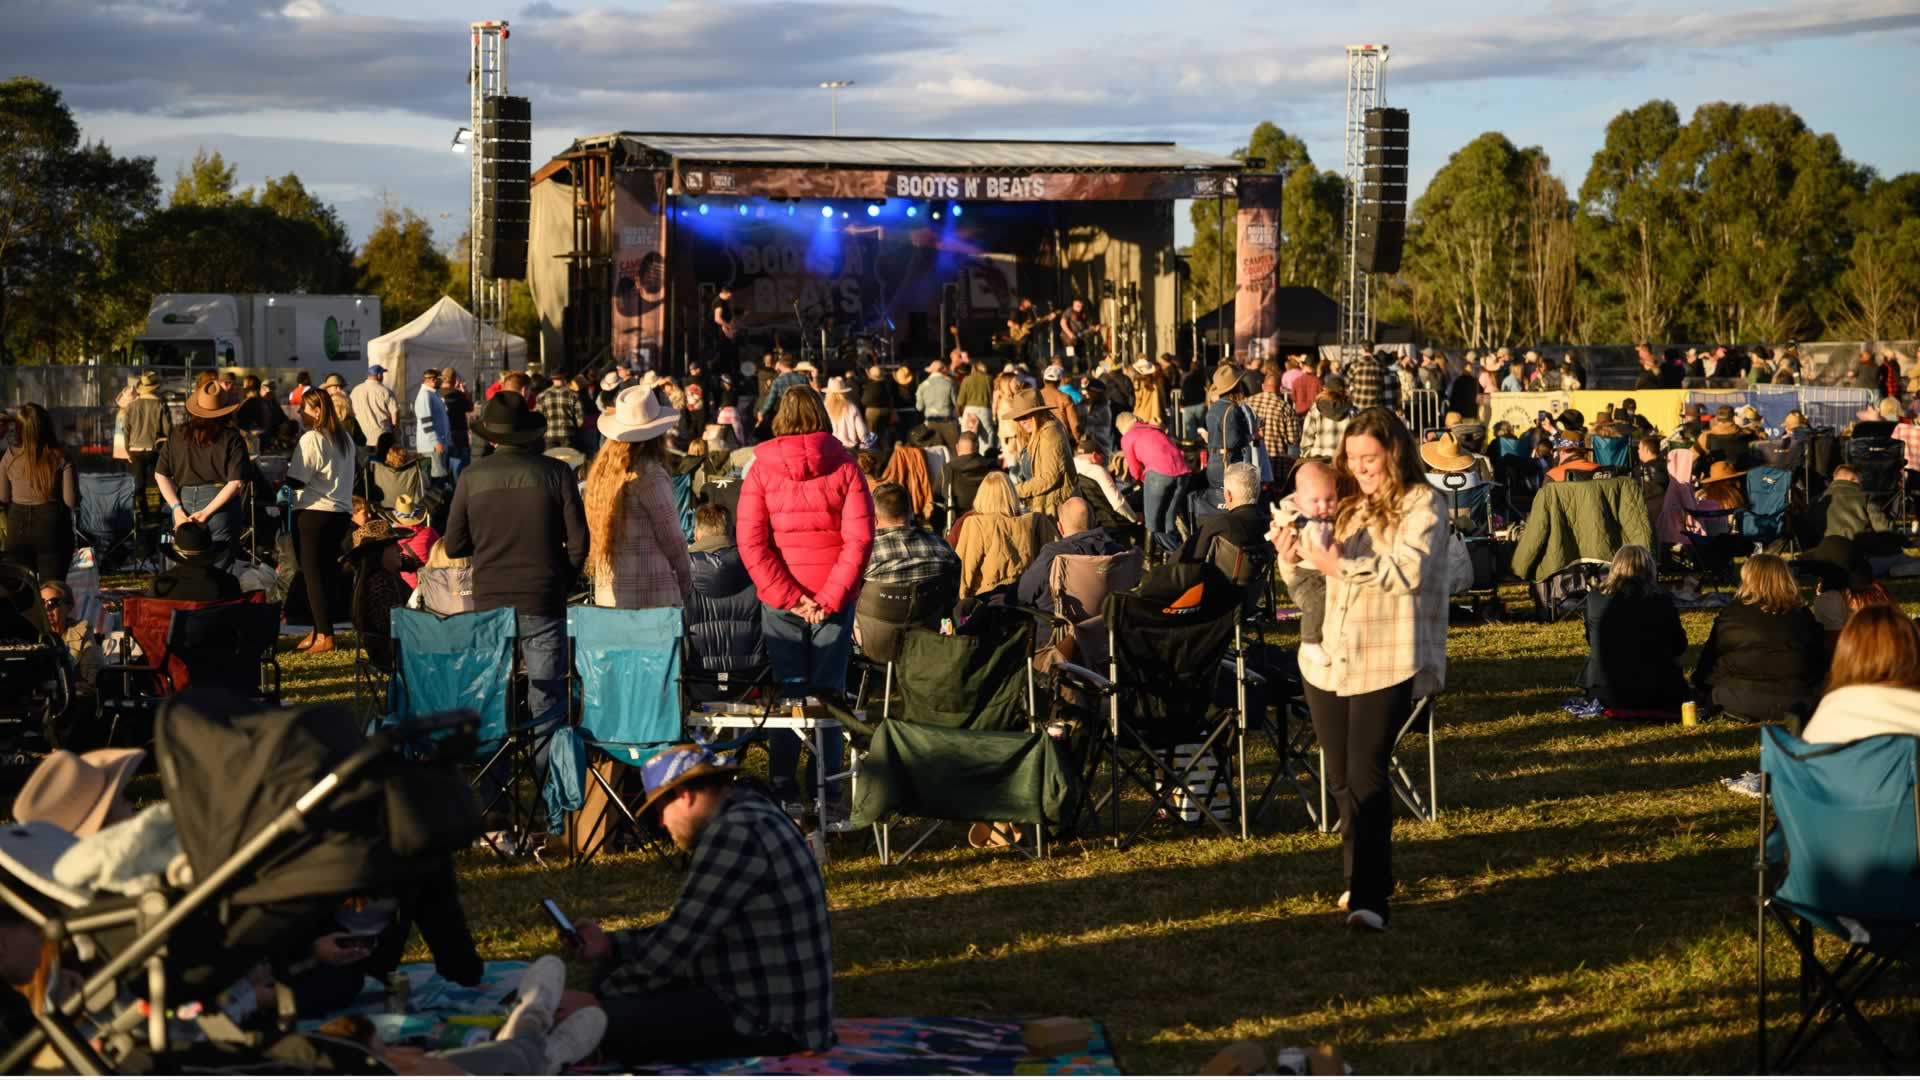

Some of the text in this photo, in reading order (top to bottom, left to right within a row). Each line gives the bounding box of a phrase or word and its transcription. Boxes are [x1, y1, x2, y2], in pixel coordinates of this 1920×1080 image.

[896, 175, 1045, 198] BOOTS N' BEATS
[753, 278, 863, 315] BEATS
